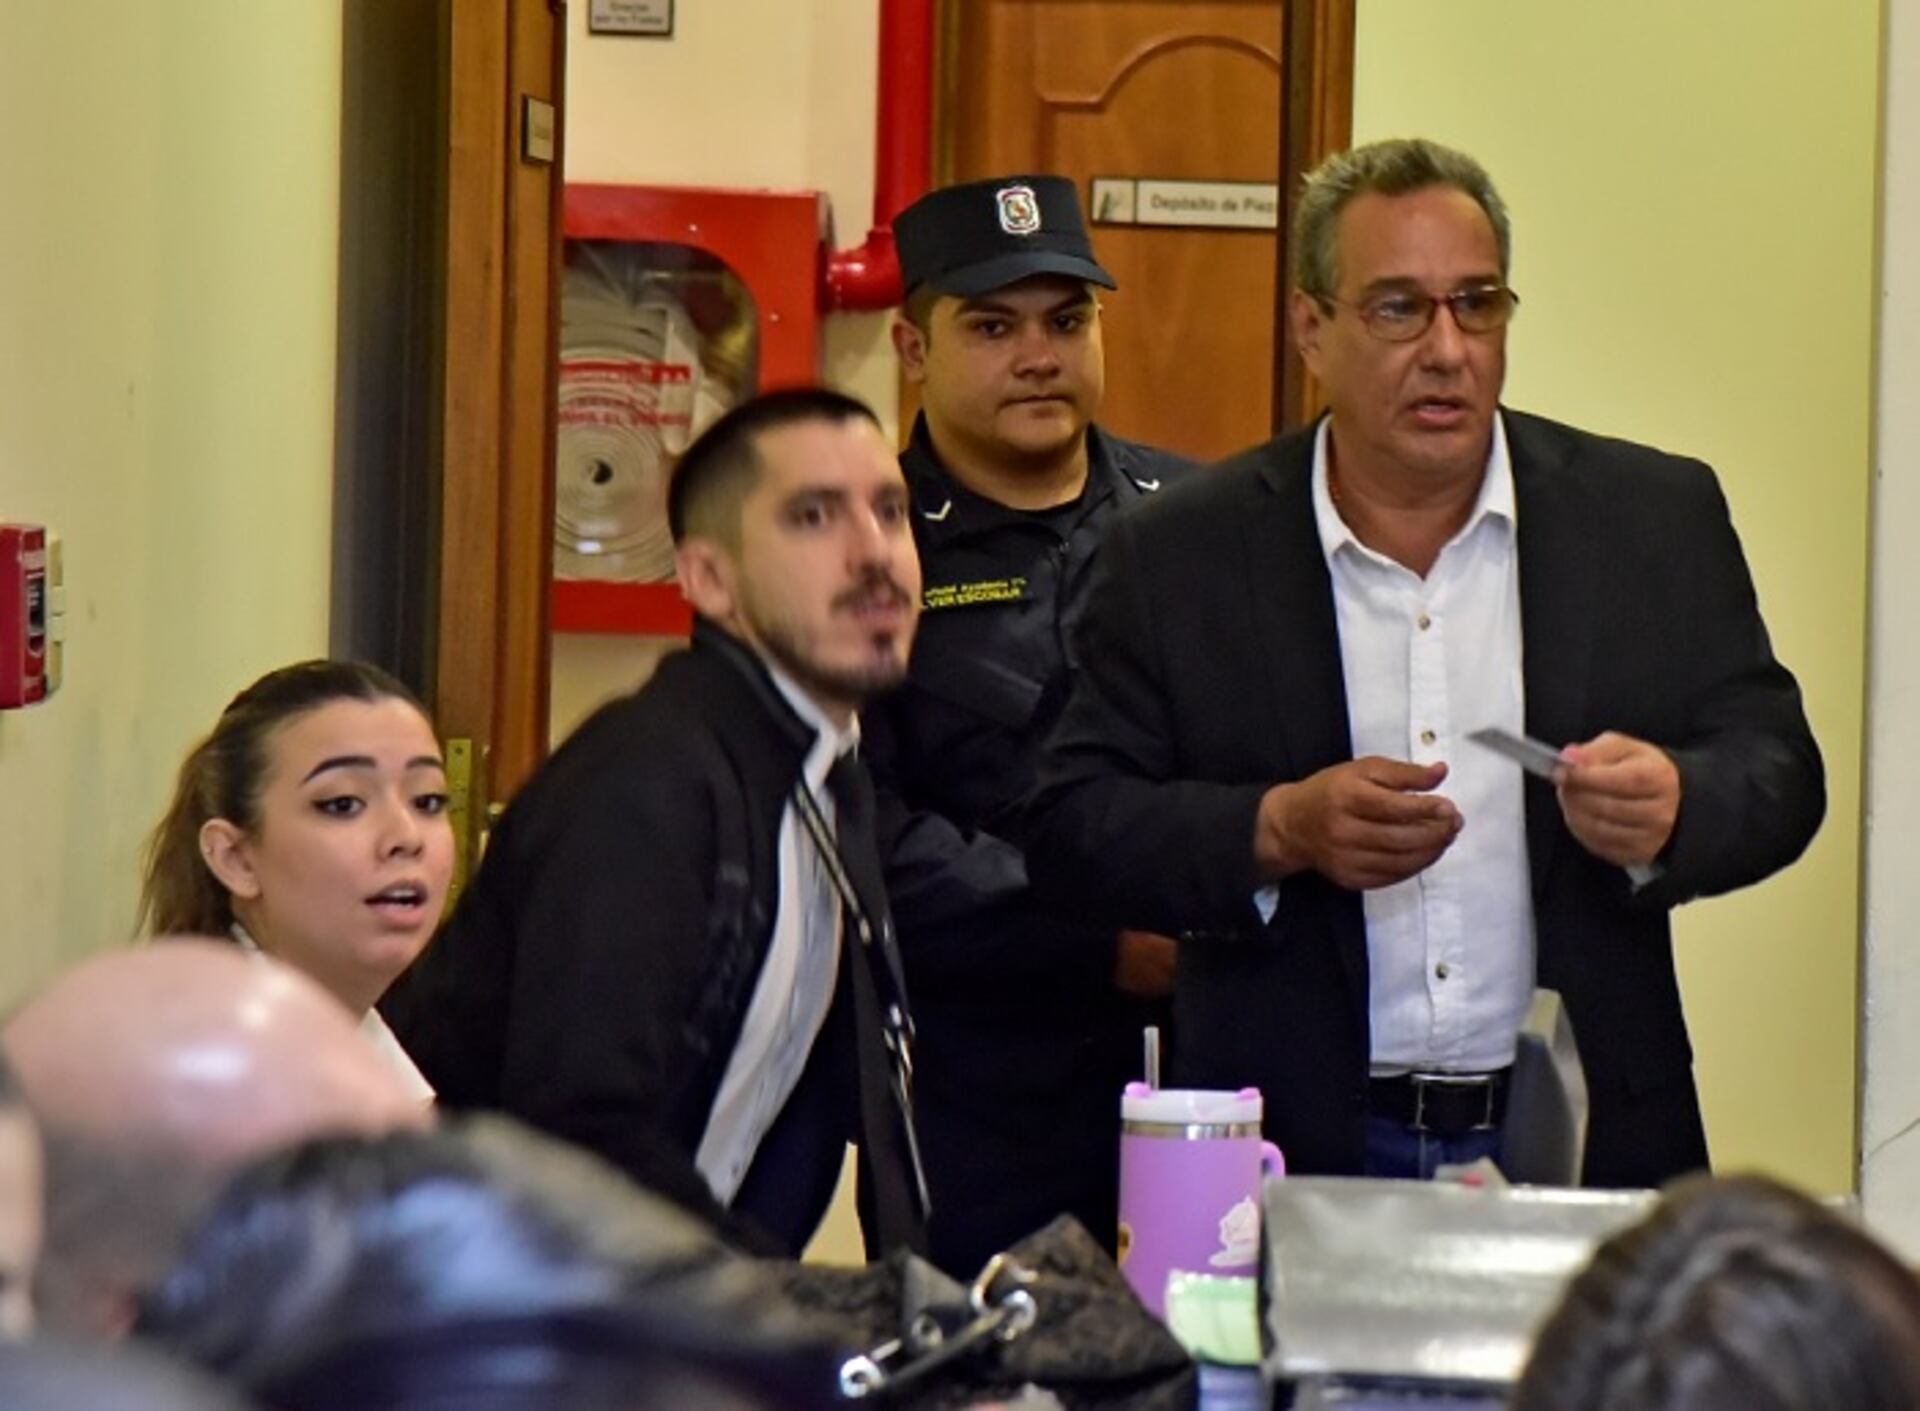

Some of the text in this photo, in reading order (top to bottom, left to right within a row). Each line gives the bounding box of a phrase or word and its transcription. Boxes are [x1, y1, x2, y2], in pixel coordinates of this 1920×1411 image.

[1221, 198, 1238, 212] de
[922, 587, 1021, 609] VER ESCOBAR
